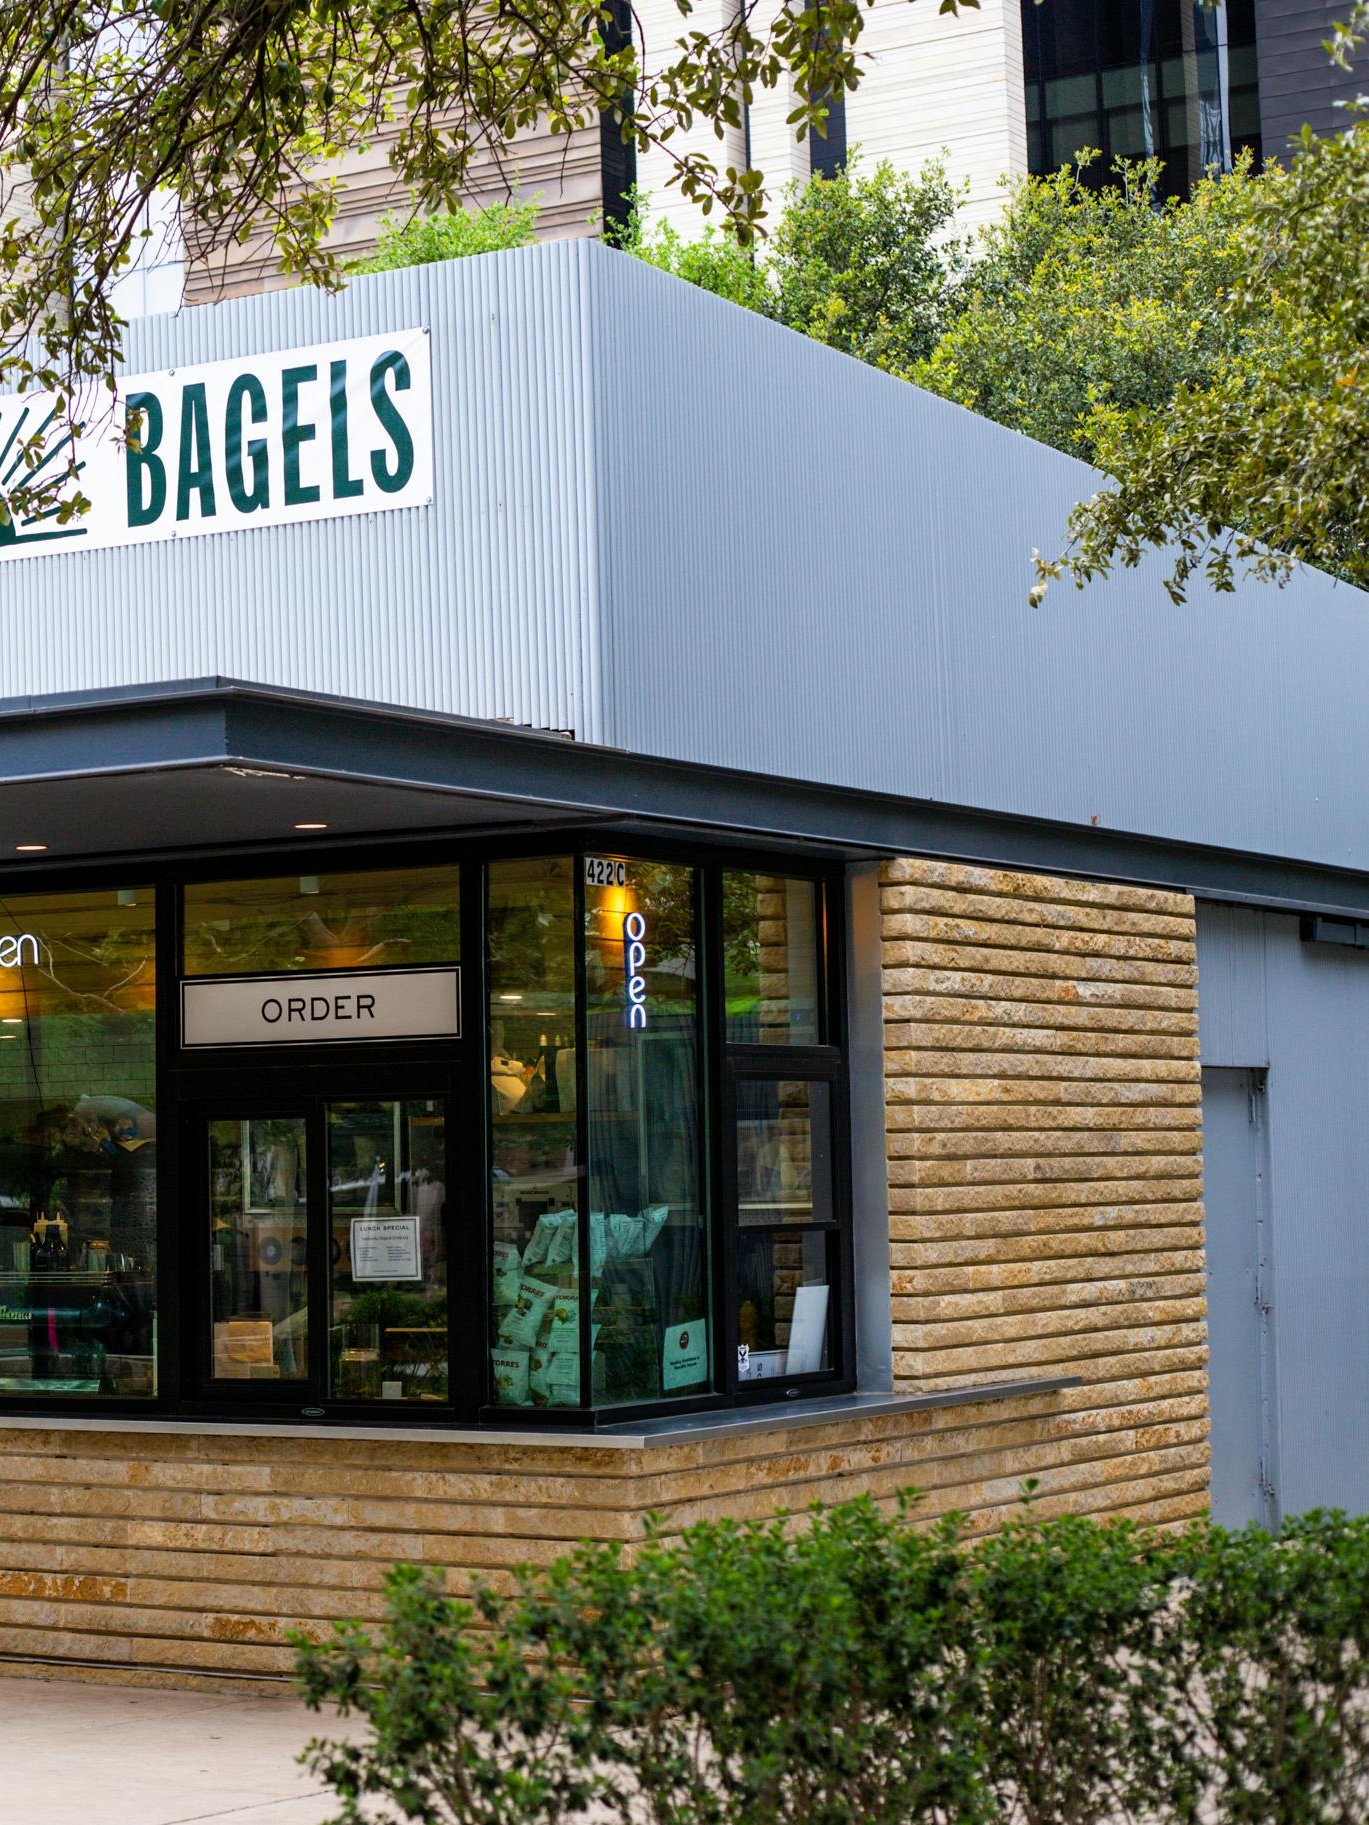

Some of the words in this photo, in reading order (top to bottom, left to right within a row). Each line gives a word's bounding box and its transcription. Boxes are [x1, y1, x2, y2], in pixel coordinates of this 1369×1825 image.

[125, 349, 415, 529] BAGELS
[261, 994, 376, 1023] ORDER
[626, 912, 646, 1028] open
